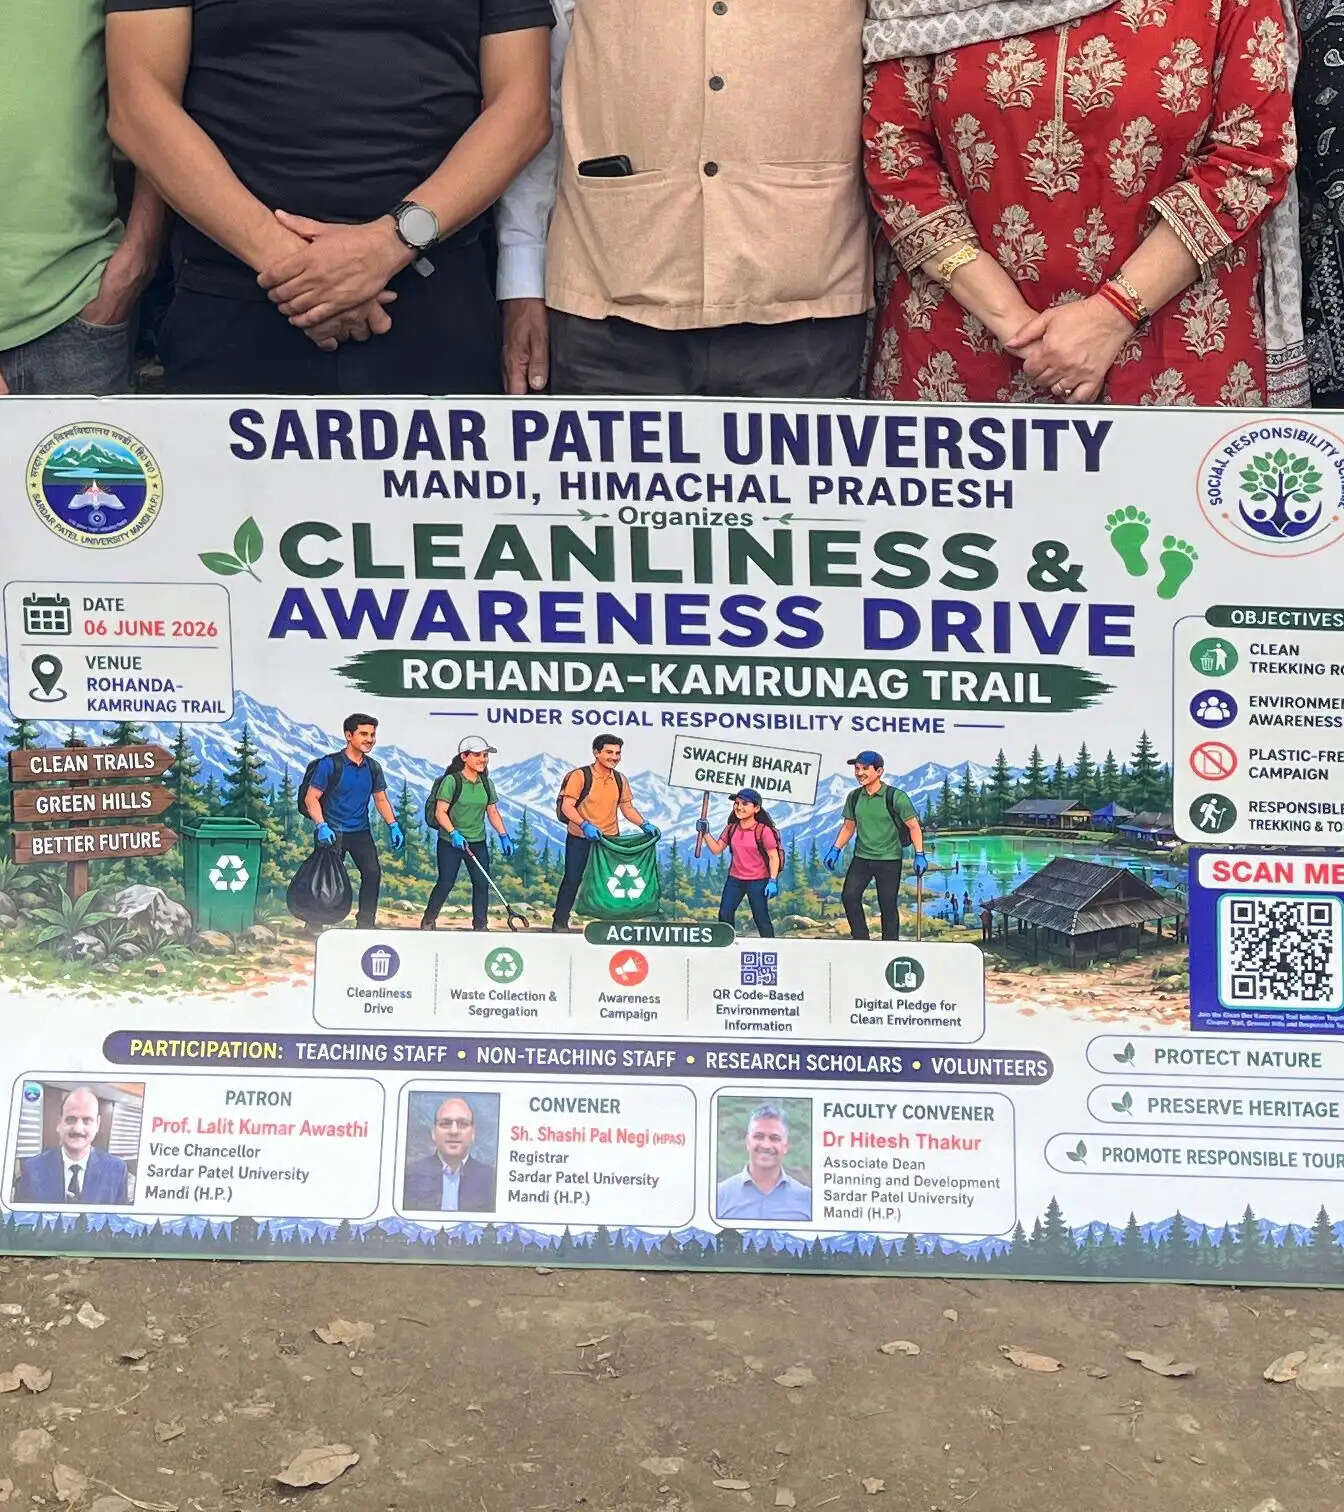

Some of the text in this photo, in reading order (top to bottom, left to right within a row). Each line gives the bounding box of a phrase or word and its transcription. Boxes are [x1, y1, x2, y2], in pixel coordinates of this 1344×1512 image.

[229, 408, 1114, 473] SARDAR PATEL UNIVERSITY
[1207, 458, 1230, 506] SOCIAL
[1223, 426, 1340, 458] RESPONSIBILITY
[382, 468, 1015, 510] MANDI, HIMACHAL PRADESH
[617, 505, 754, 531] Organizes
[278, 521, 1088, 594] CLEANLINESS &
[82, 597, 126, 614] DATE
[268, 587, 1137, 658] AWARENESS DRIVE
[1230, 609, 1344, 629] OBJECTIVES
[84, 620, 218, 639] 06 JUNE 2026
[1248, 643, 1300, 657] CLEAN
[85, 655, 142, 671] VENUE
[1248, 662, 1326, 677] TREKKING
[86, 677, 184, 694] ROHANDA-
[402, 659, 1053, 705] ROHANDA-KAMRUNAG TRAIL
[87, 697, 226, 716] KAMRUNAG TRAIL
[486, 707, 946, 735] UNDER SOCIAL RESPONSIBILITY SCHEME
[1248, 713, 1344, 729] AWARENESS
[29, 752, 155, 774] CLEAN TRAILS
[682, 745, 812, 776] SWACHH BHARAT
[694, 768, 793, 794] GREEN INDIA
[1248, 766, 1330, 781] CAMPAIGN
[35, 790, 152, 814] GREEN HILLS
[1248, 818, 1312, 833] TREKKING
[1314, 820, 1324, 834] &
[31, 830, 162, 855] BETTER FUTURE
[1212, 859, 1294, 883] SCAN
[605, 924, 713, 945] ACTIVITIES
[346, 987, 412, 1000] Cleanliness
[450, 989, 558, 1003] Waste Collection &
[598, 992, 661, 1006] Awareness
[712, 989, 805, 1004] QR Code-Based
[364, 1002, 394, 1016] Drive
[468, 1004, 538, 1019] Segregation
[599, 1007, 658, 1022] Campaign
[715, 1004, 800, 1018] Environmental
[854, 997, 957, 1014] Digital Pledge for
[724, 1019, 794, 1033] Information
[848, 1012, 962, 1029] Clean Environment
[128, 1039, 1049, 1078] PARTICIPATION: TEACHING STAFF NON-TEACHING STAFF RESEARCH SCHOLARS VOLUNTEERS
[1154, 1047, 1322, 1069] PROTECT NATURE
[224, 1089, 292, 1107] PATRON
[528, 1096, 622, 1115] CONVENER
[1147, 1096, 1340, 1119] PRESERVE HERITAGE
[822, 1102, 995, 1123] FACULTY CONVENER
[151, 1117, 368, 1139] Prof. Lalit Kumar Awasthi
[509, 1126, 687, 1149] Sh. Shashi Pal Negi (HPAS)
[148, 1142, 262, 1160] Vice Chancellor
[822, 1131, 982, 1152] Dr Hitesh Thakur
[508, 1150, 569, 1167] Registrar
[823, 1156, 926, 1171] Associate Dean
[1101, 1146, 1183, 1166] PROMOTE
[1187, 1148, 1298, 1168] RESPONSIBLE
[146, 1164, 310, 1186] Sardar Patel University
[508, 1169, 660, 1190] Sardar Patel University
[823, 1173, 1000, 1192] Planning and Development
[144, 1186, 233, 1204] Mandi (H.P.)
[507, 1189, 591, 1207] Mandi (H.P.)
[823, 1190, 974, 1209] Sardar Patel University
[823, 1206, 902, 1223] Mandi (H.P.)
